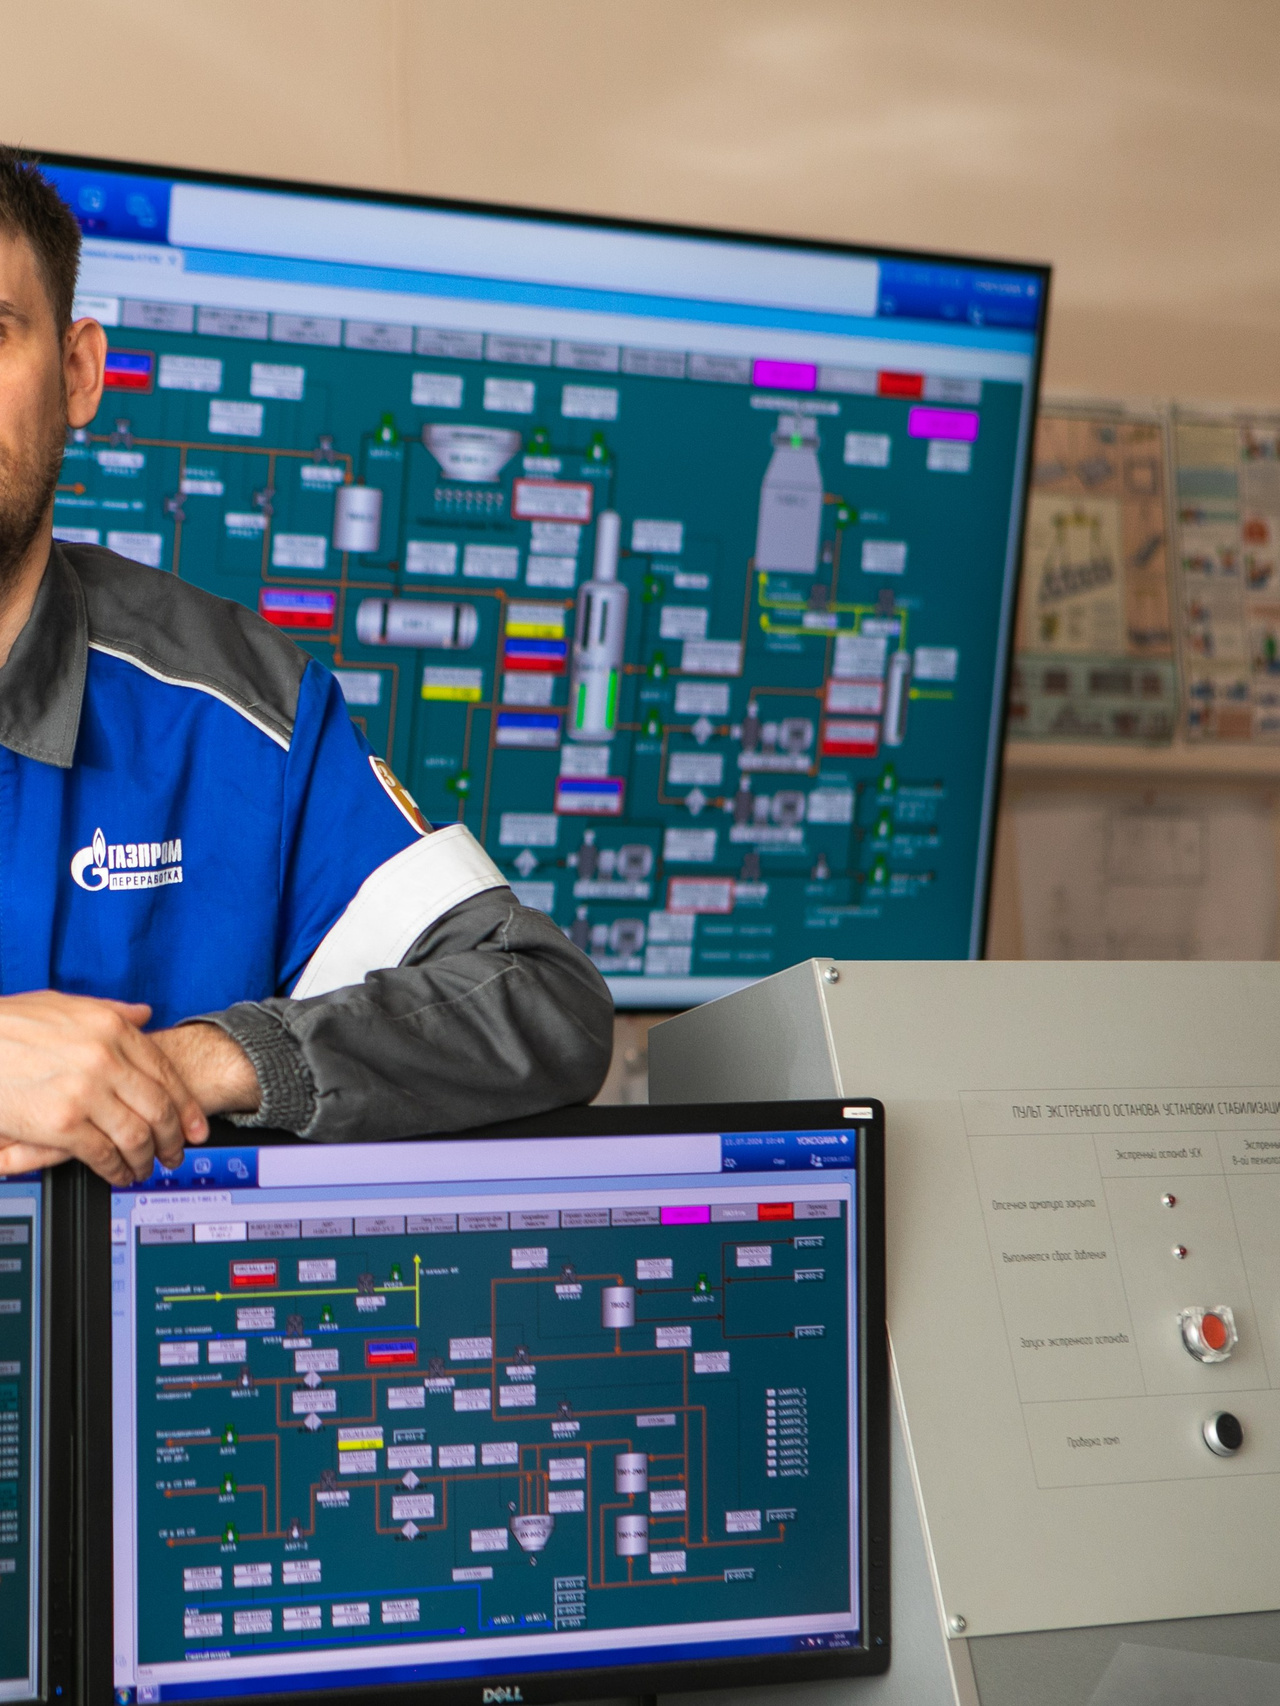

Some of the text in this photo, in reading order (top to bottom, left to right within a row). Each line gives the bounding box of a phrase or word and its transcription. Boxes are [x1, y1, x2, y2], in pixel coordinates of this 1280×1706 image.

[107, 838, 182, 869] ГАЗПРОМ
[112, 869, 180, 887] ПЕРЕРАБОТКА
[1012, 1105, 1042, 1118] ПУЛЬТ
[1046, 1104, 1110, 1118] ЭКСТРЕННОГО
[1113, 1103, 1160, 1116] ОСТАНОВА
[1163, 1102, 1215, 1115] УСТАНОВКИ
[482, 1685, 523, 1704] DELL
